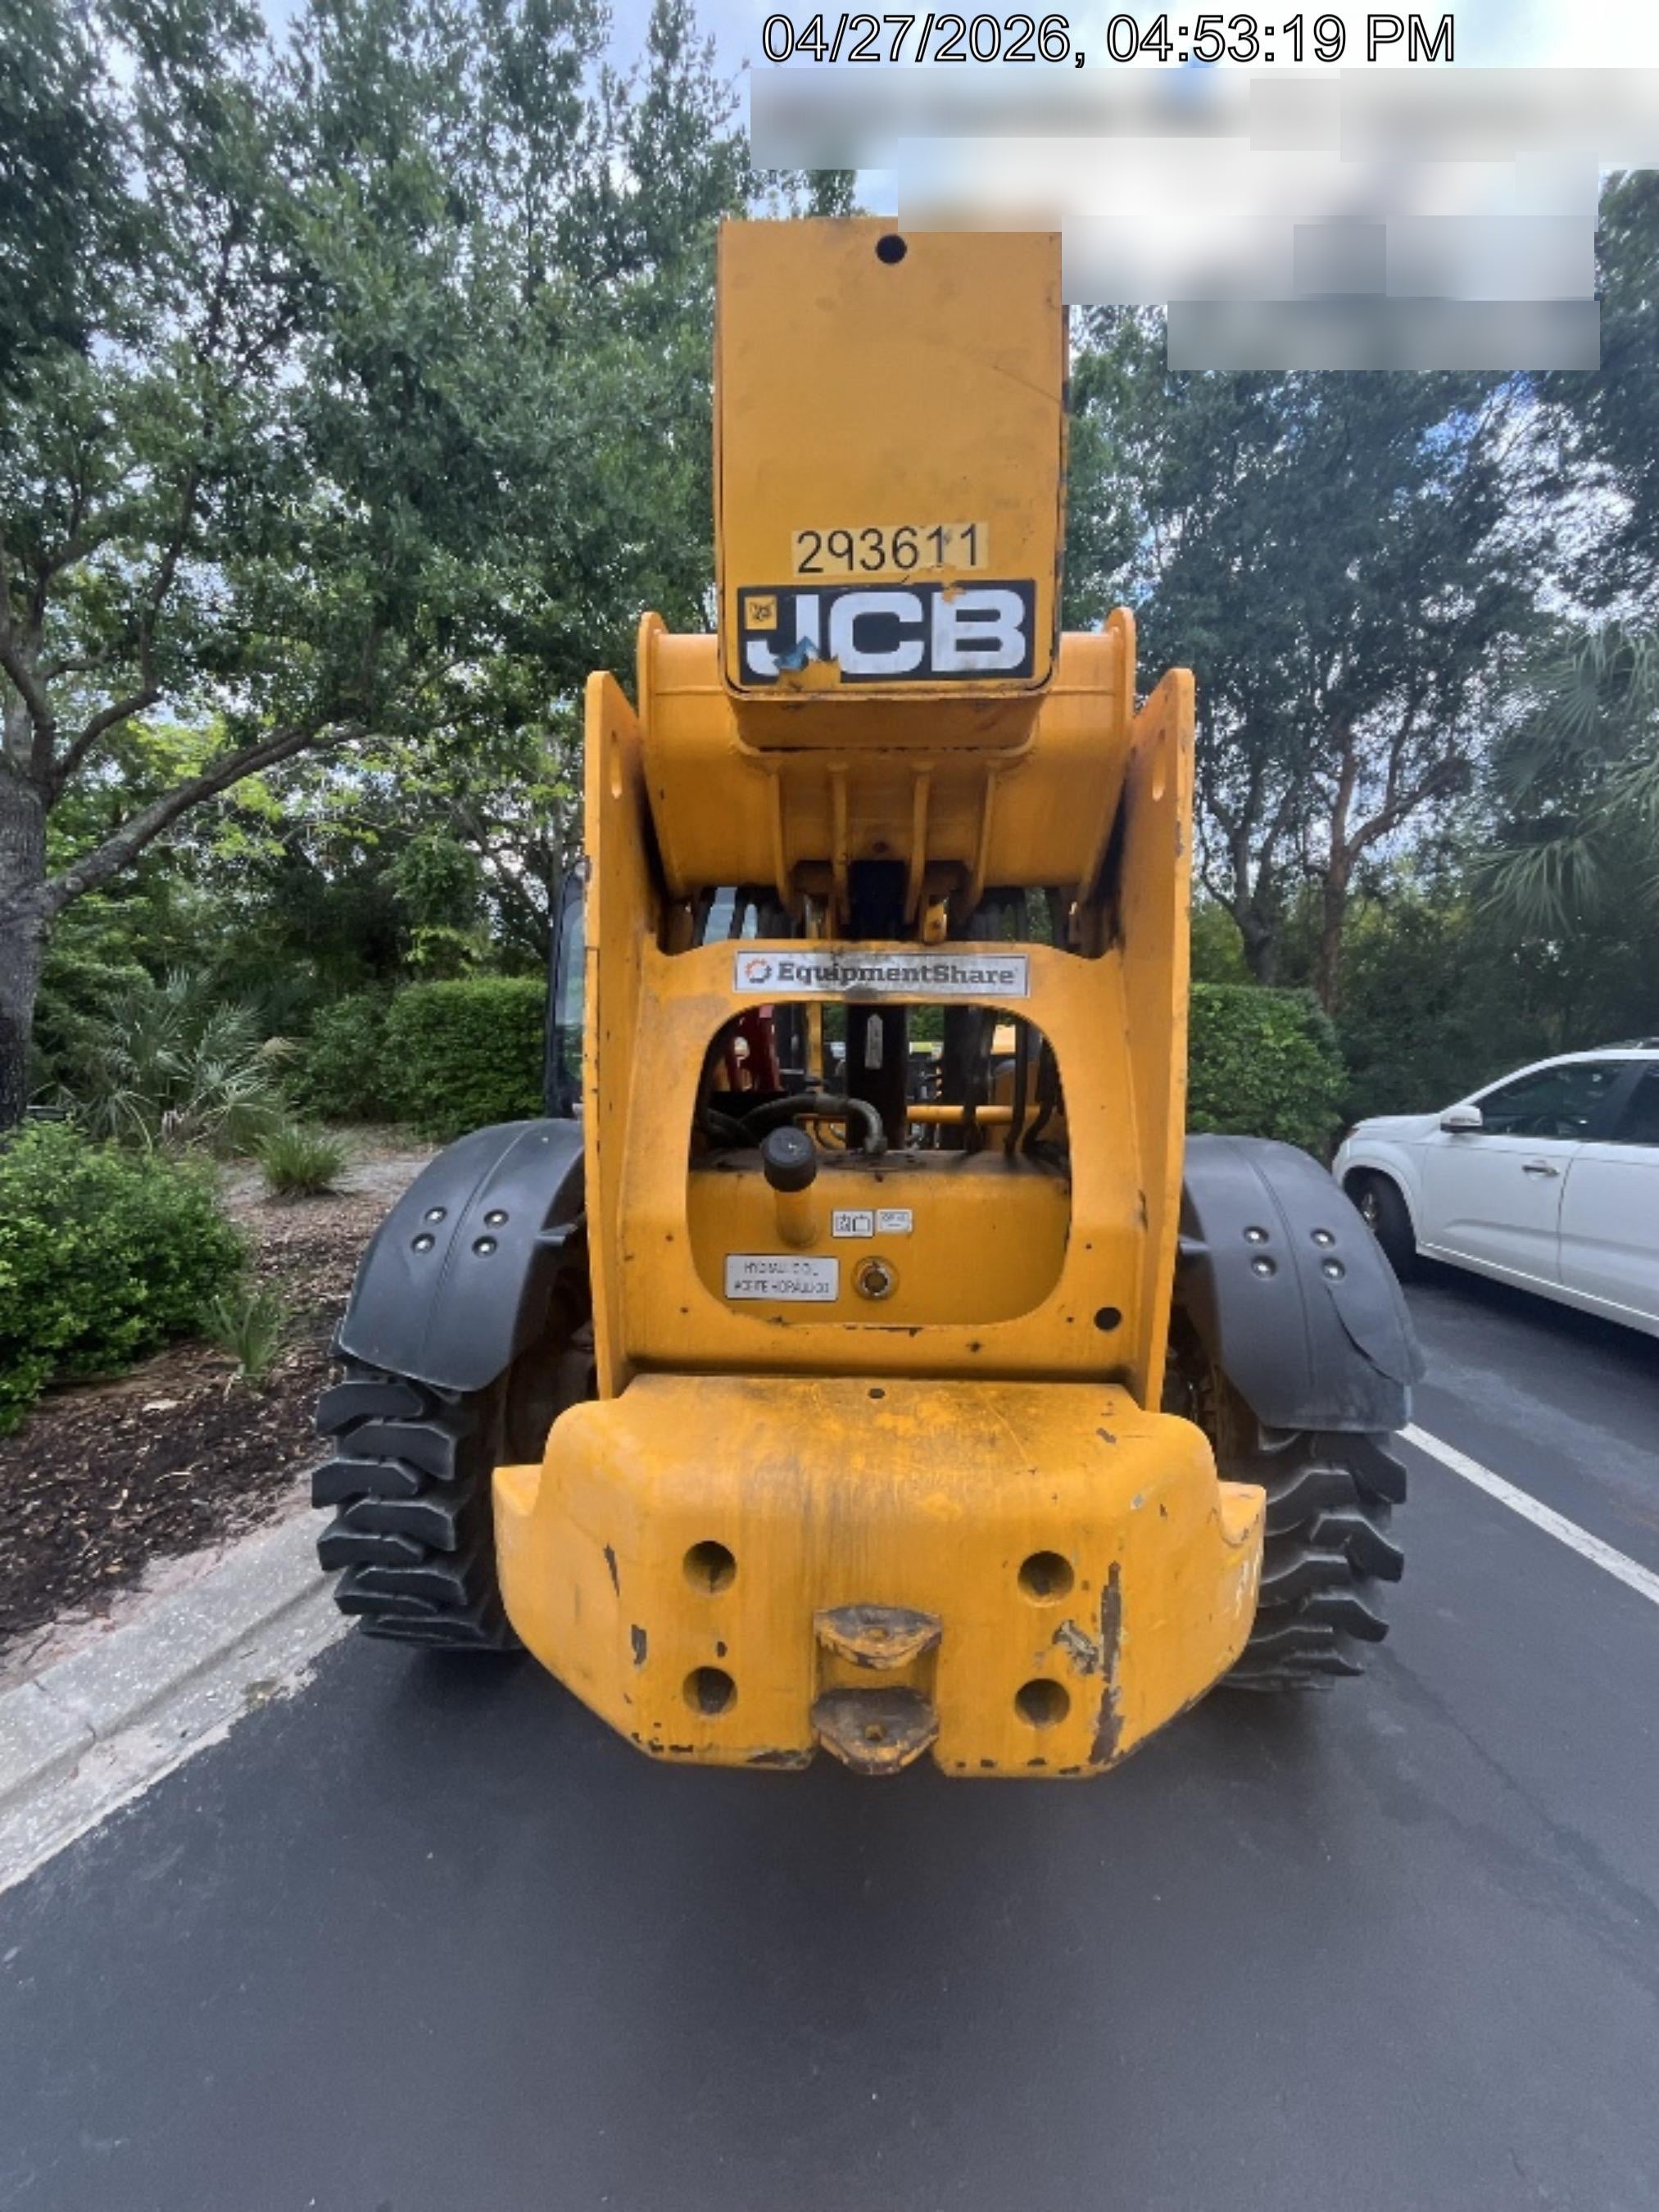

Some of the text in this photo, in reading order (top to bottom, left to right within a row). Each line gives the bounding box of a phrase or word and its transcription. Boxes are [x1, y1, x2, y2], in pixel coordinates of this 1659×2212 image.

[796, 523, 977, 573] 293611
[745, 588, 1027, 676] JCB
[777, 961, 1015, 986] EquipmentShare
